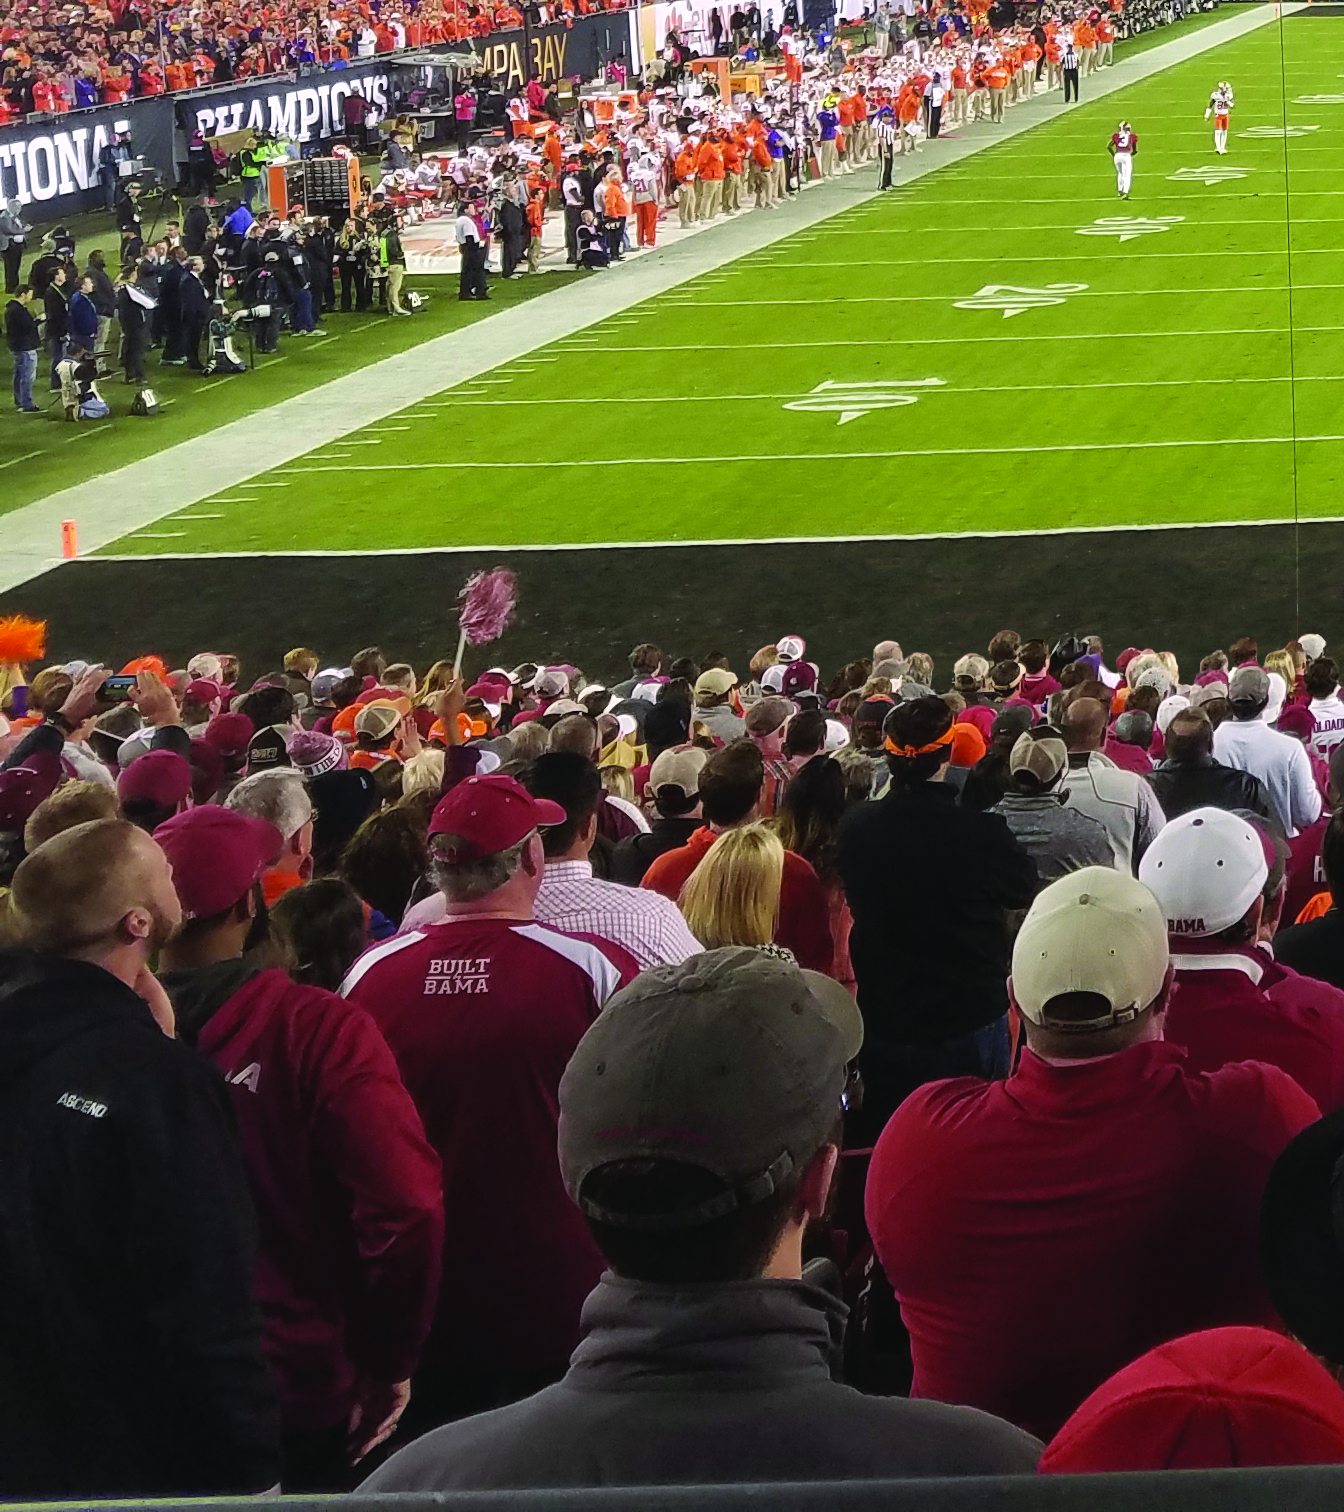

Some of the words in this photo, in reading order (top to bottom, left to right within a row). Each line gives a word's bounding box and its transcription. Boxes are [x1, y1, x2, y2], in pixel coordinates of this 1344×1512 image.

[1118, 134, 1130, 150] 3
[632, 178, 648, 194] 21
[429, 958, 491, 975] BUILT
[423, 979, 490, 995] BAMA
[56, 1091, 109, 1119] ASCEND
